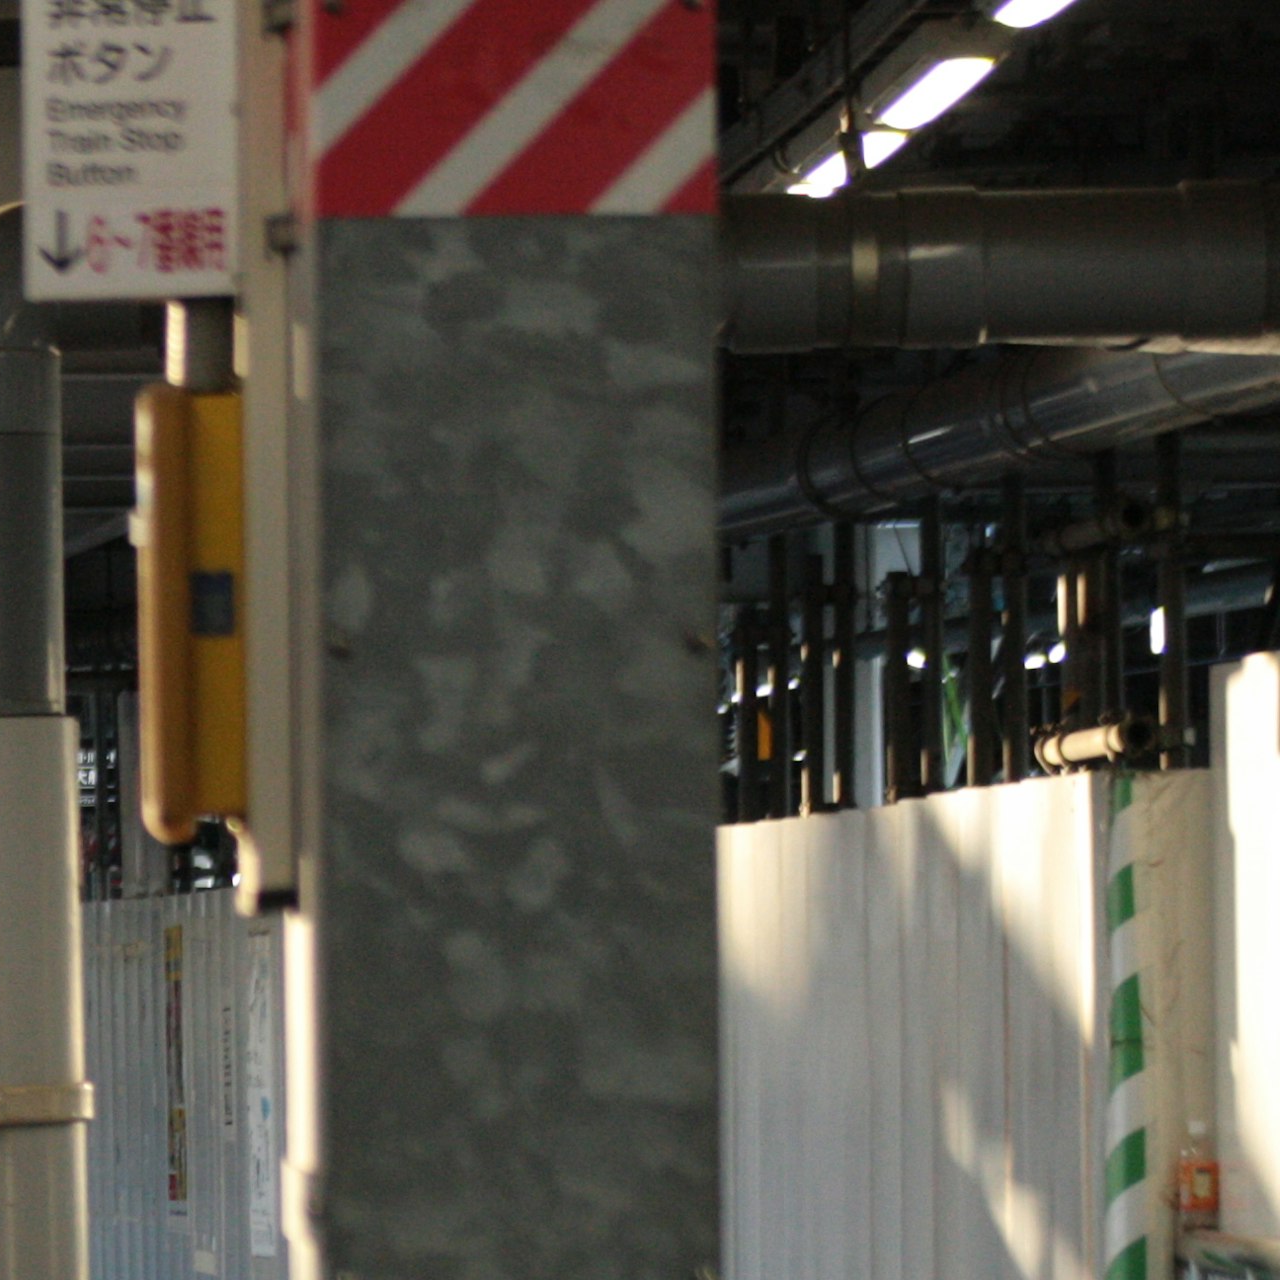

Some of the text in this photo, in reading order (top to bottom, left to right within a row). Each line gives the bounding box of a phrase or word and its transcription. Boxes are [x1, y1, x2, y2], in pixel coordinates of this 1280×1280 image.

[48, 41, 172, 83] ボタン
[47, 99, 186, 126] Emergency
[47, 127, 183, 153] Train Stop
[47, 162, 136, 187] Button
